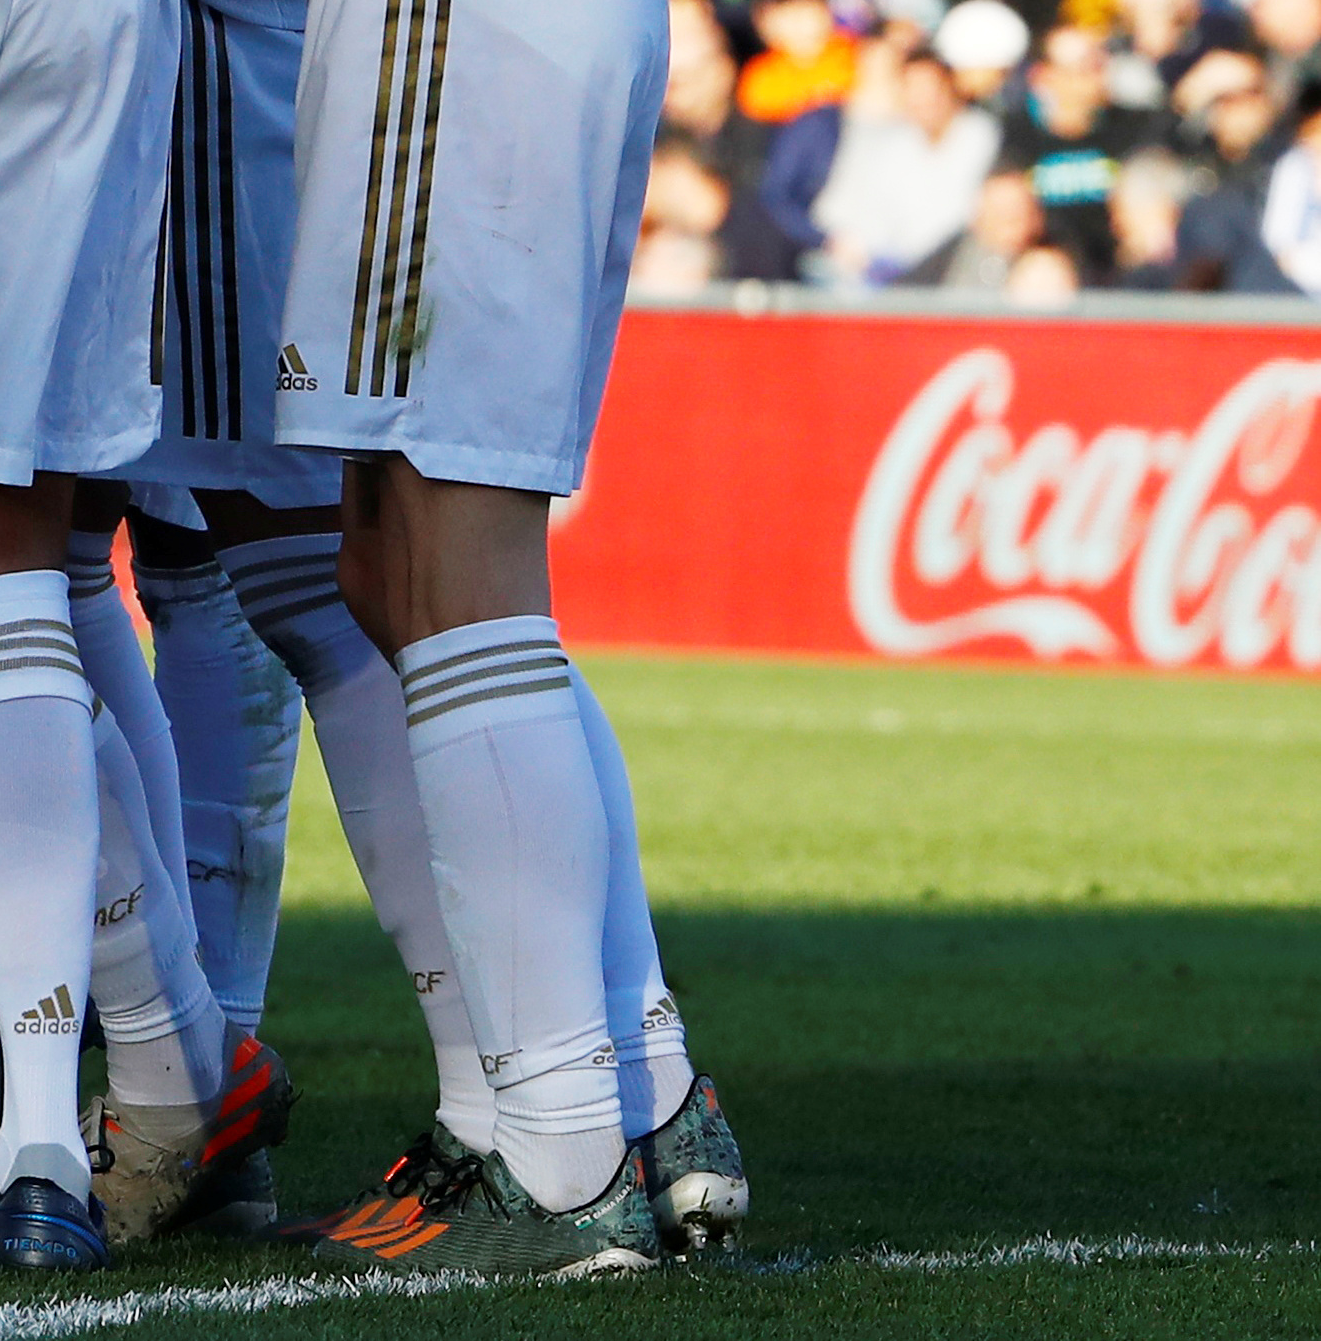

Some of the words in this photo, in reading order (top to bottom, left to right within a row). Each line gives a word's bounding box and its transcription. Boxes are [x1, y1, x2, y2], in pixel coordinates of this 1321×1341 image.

[410, 970, 446, 993] CF
[14, 1018, 81, 1035] adidas
[479, 1048, 523, 1074] CF
[3, 1237, 78, 1259] TIEMPO
